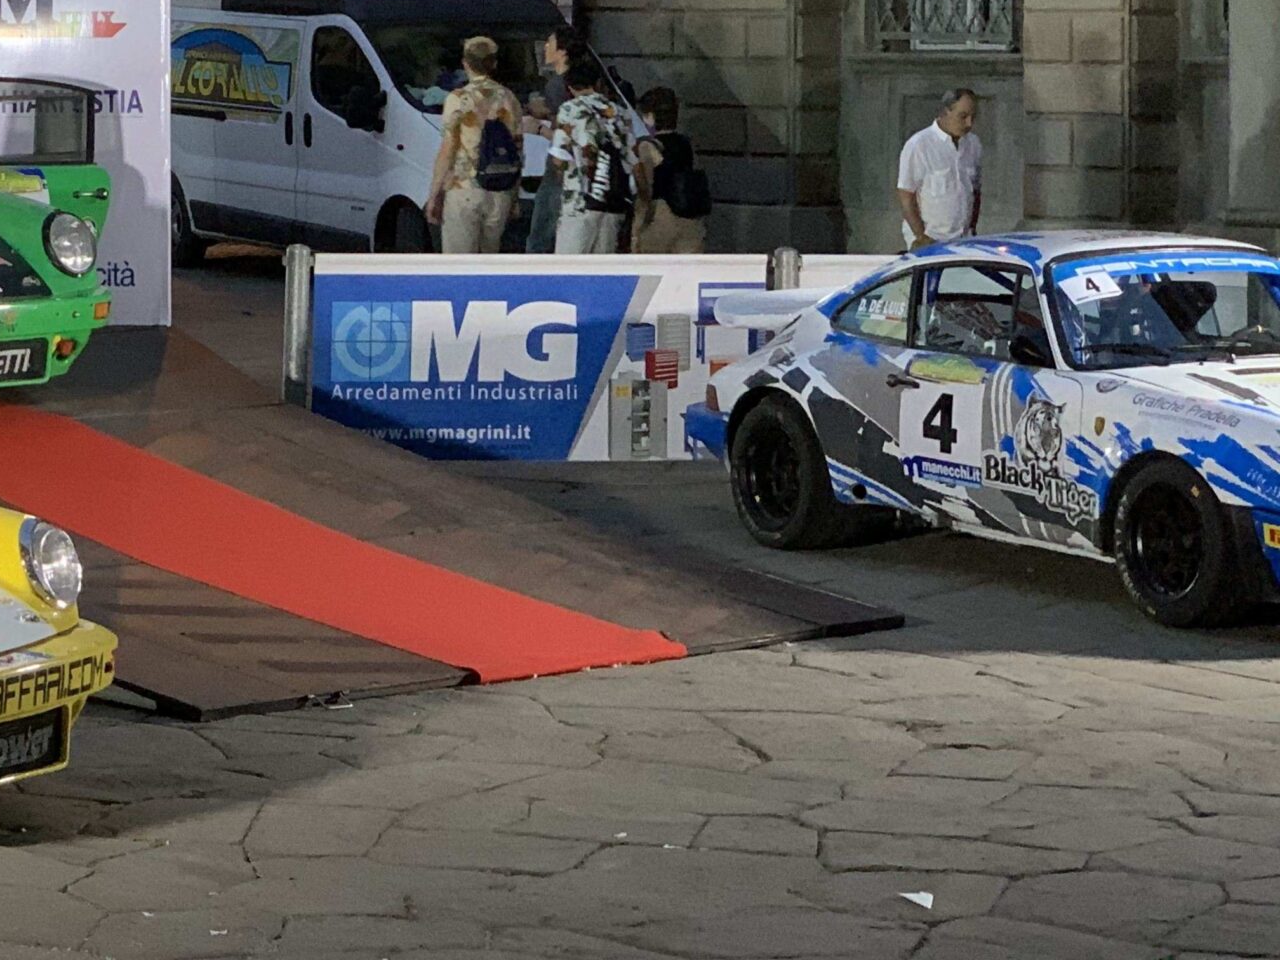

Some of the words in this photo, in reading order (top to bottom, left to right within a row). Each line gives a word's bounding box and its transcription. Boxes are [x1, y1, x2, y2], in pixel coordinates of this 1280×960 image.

[1084, 277, 1101, 293] 4
[857, 298, 867, 313] D.
[868, 299, 883, 314] DE
[883, 300, 906, 315] LUIS
[409, 300, 579, 382] MG
[331, 383, 461, 401] Arredamenti
[470, 383, 578, 401] Industriali
[1131, 391, 1187, 416] Grafiche
[1187, 405, 1243, 429] Pradella
[922, 393, 958, 454] 4
[921, 461, 982, 483] manecchi.it
[984, 454, 1044, 493] Black
[1045, 478, 1098, 522] Tiger
